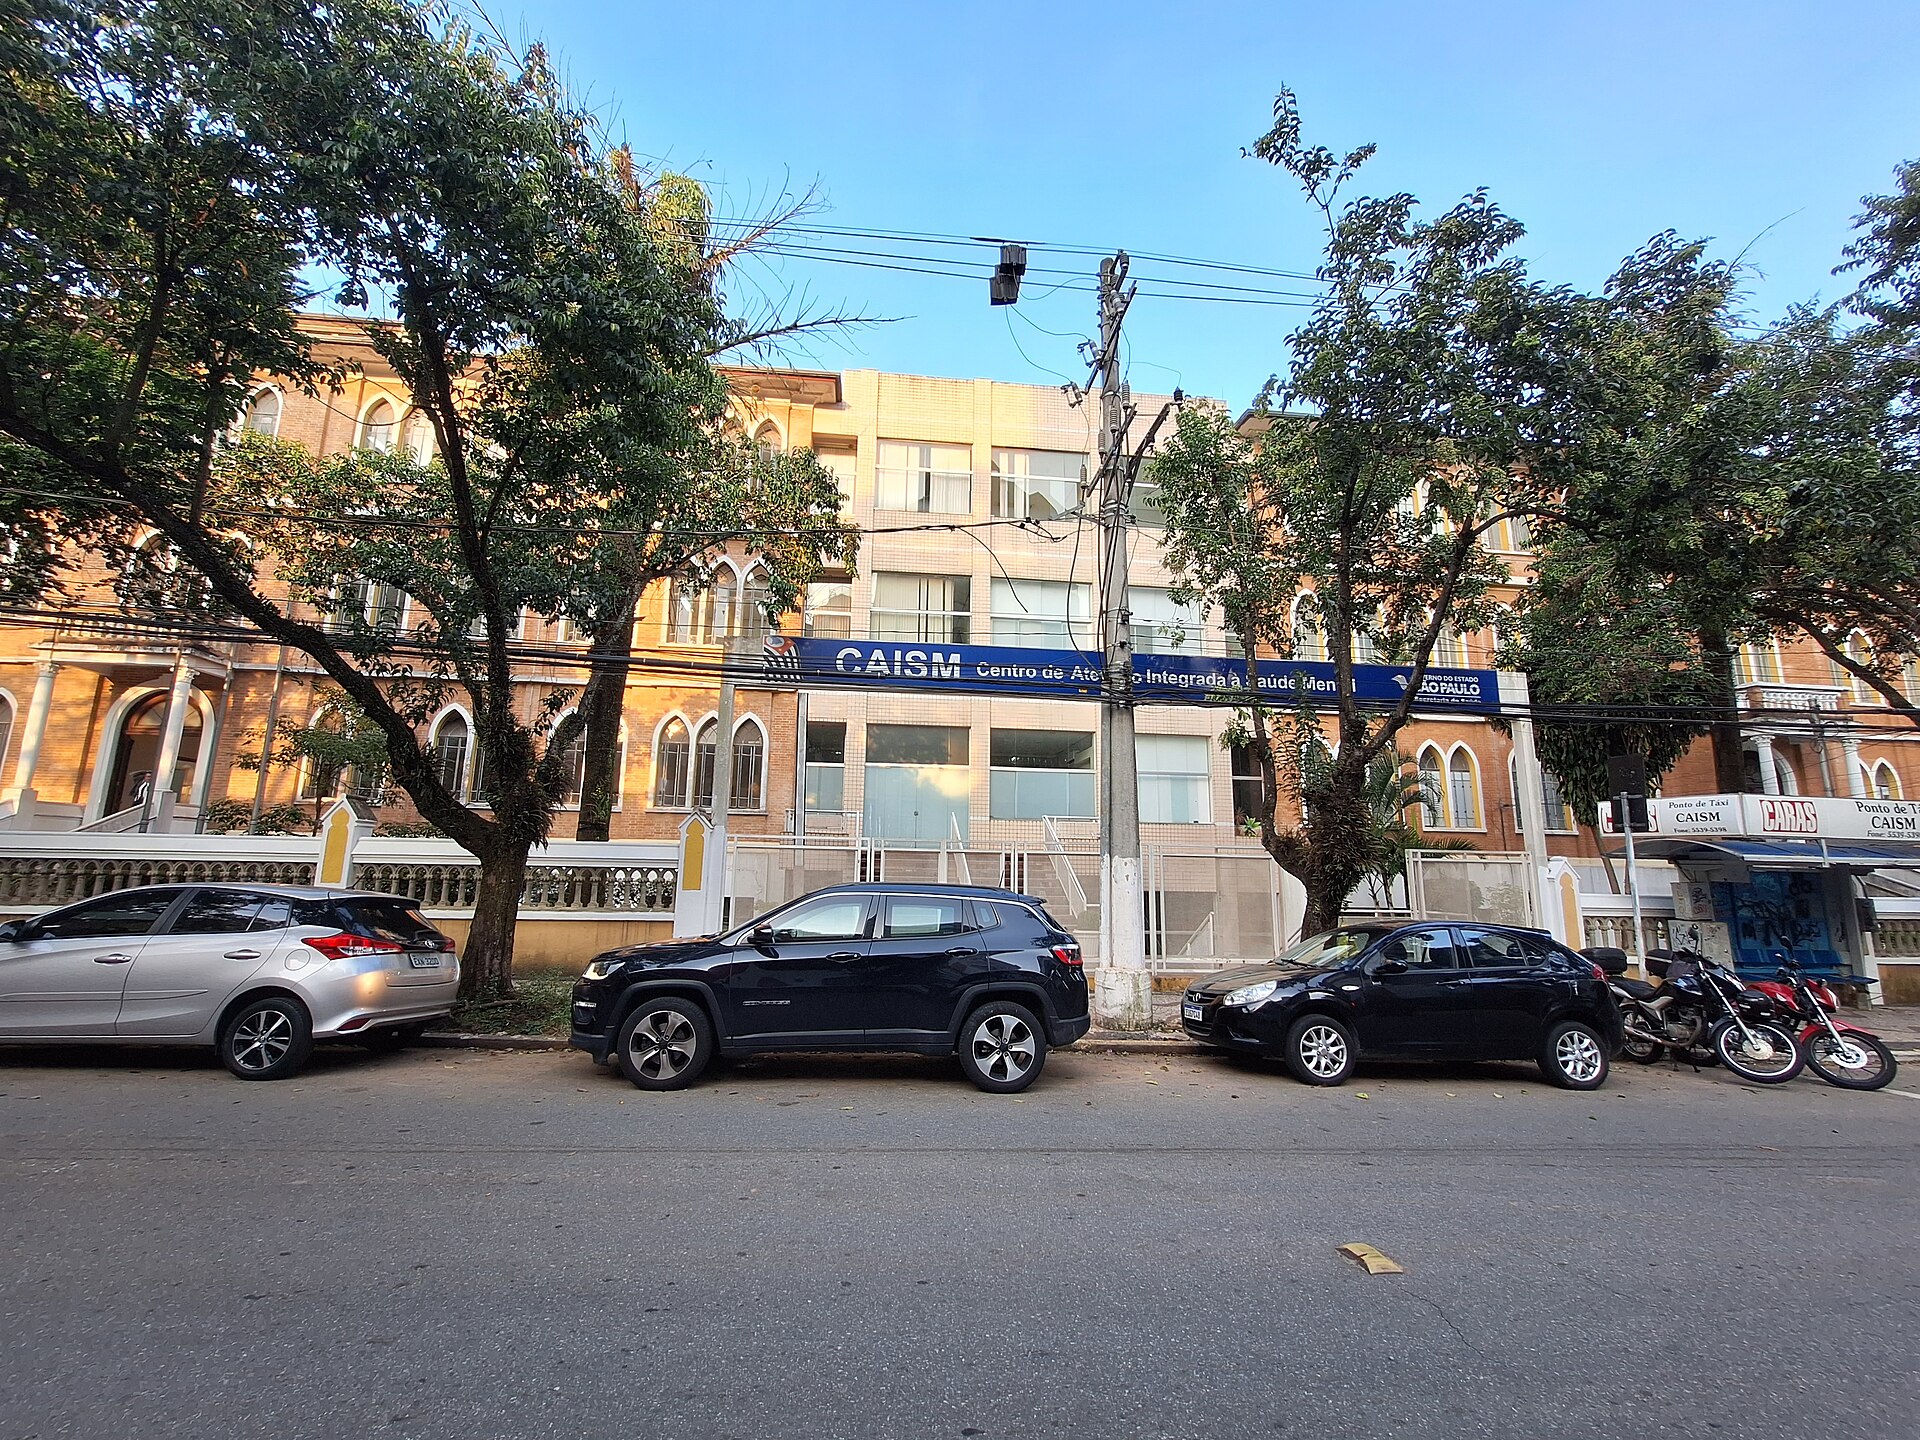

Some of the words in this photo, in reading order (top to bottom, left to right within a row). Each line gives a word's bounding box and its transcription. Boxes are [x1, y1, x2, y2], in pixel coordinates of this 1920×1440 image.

[835, 646, 961, 678] CAISM
[976, 661, 1038, 679] Centro
[1042, 664, 1064, 680] de
[1146, 668, 1226, 688] Integrada
[1418, 681, 1439, 693] ÃO
[1440, 682, 1480, 695] PAULO
[1668, 801, 1694, 809] Ponto
[1695, 800, 1707, 808] de
[1710, 799, 1729, 807] Táxi
[1855, 801, 1890, 814] Ponto
[1893, 803, 1908, 815] de
[1675, 811, 1721, 823] CAISM
[1760, 800, 1817, 833] CARAS
[1871, 815, 1917, 830] CAISM
